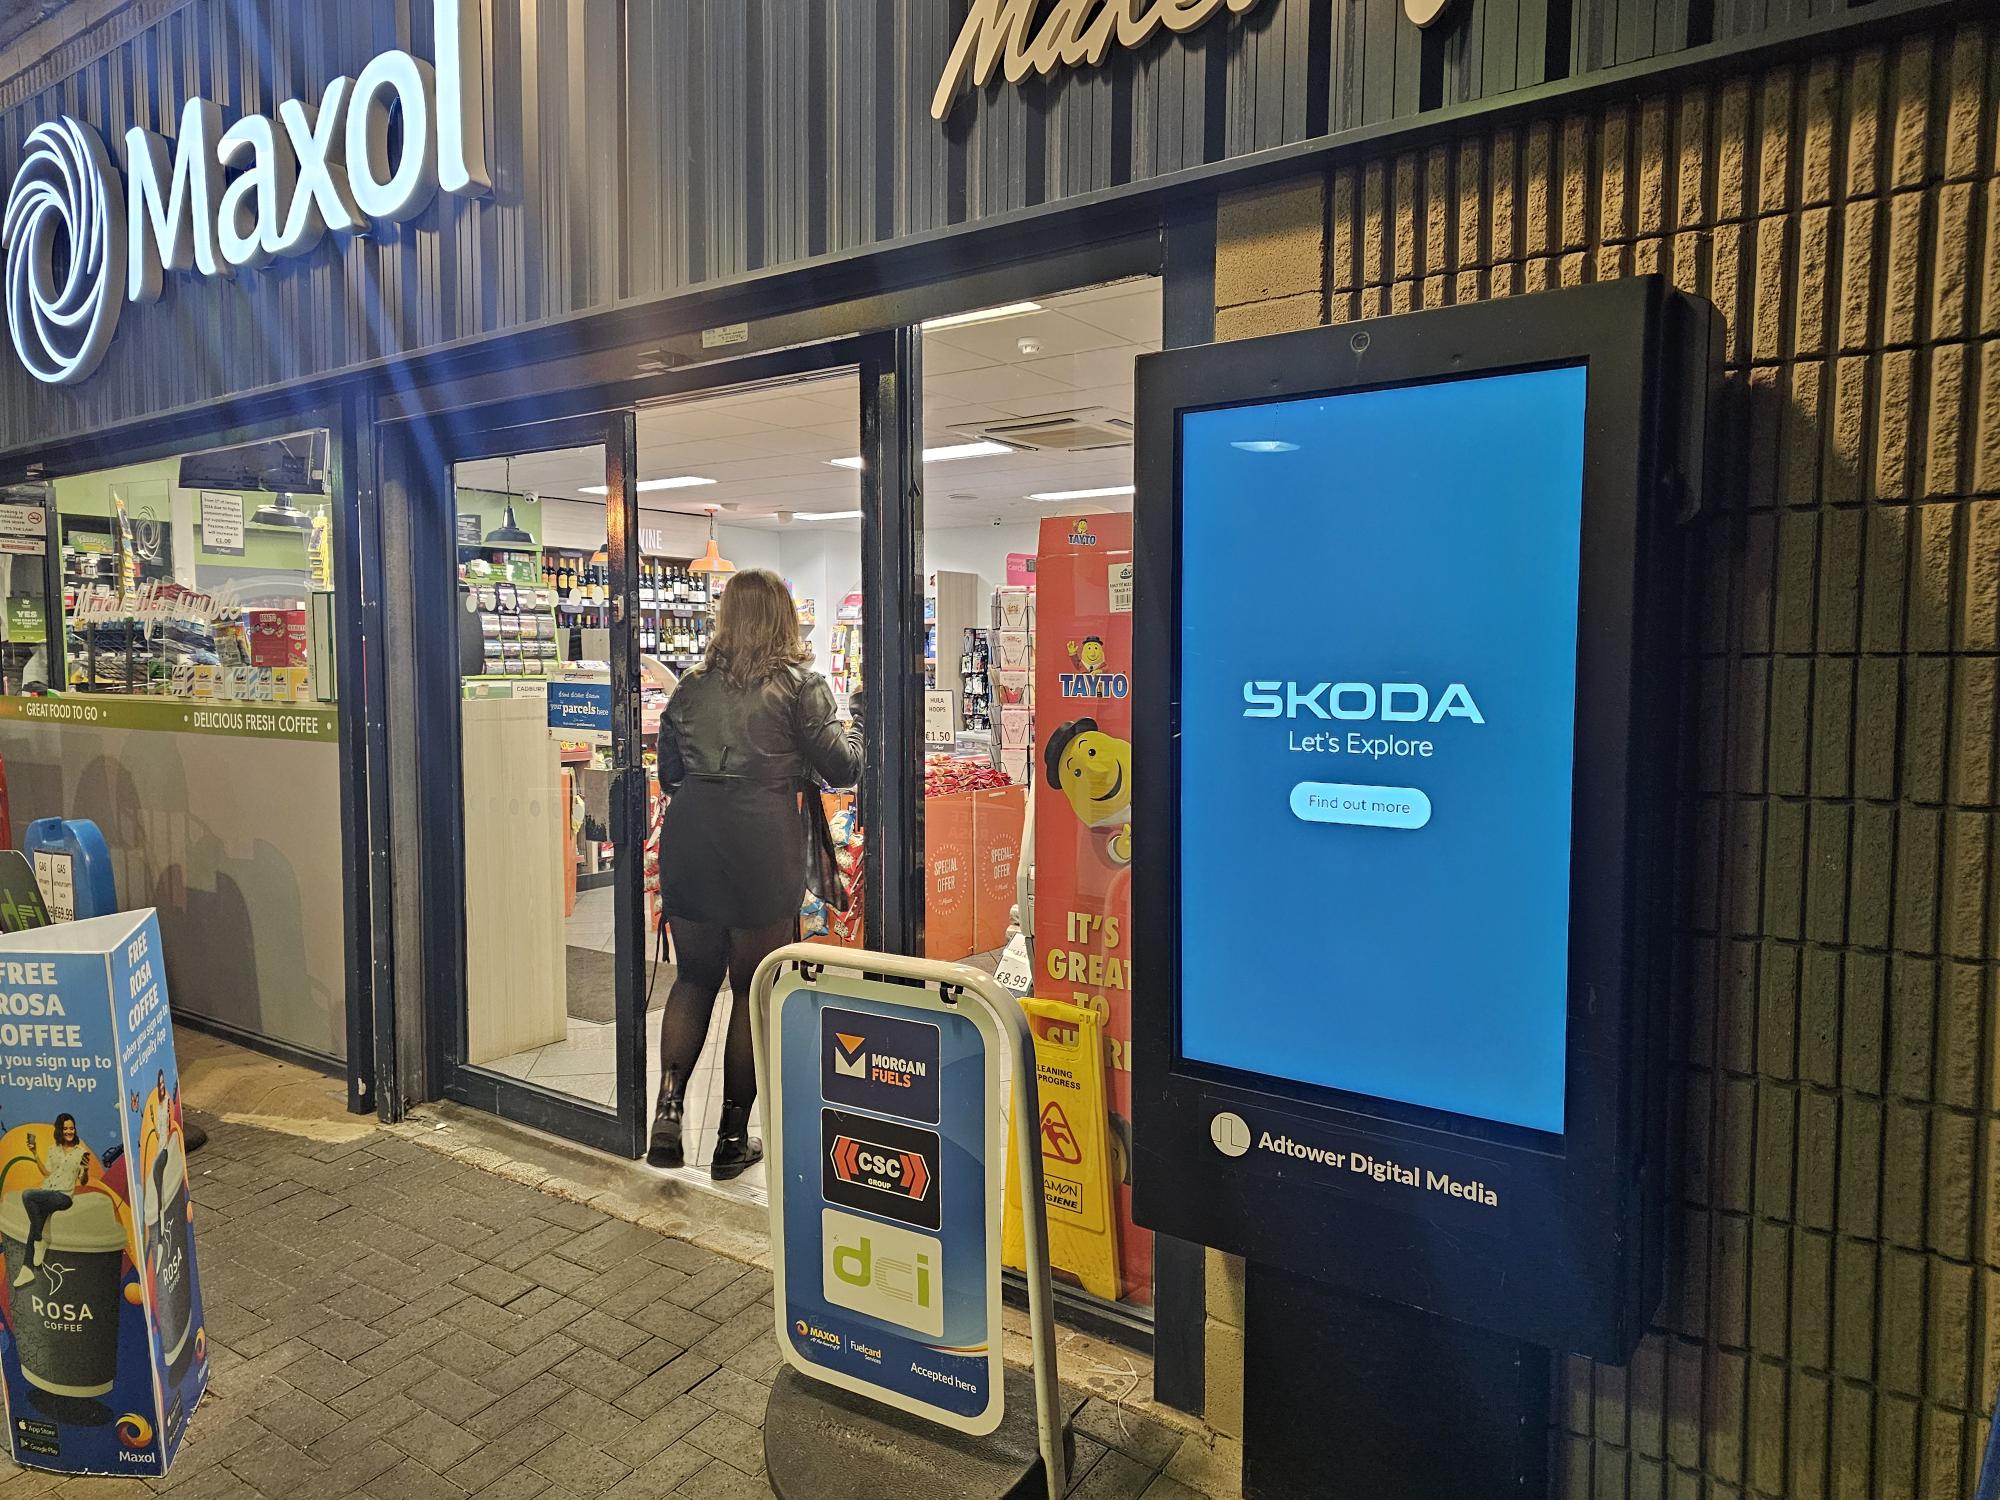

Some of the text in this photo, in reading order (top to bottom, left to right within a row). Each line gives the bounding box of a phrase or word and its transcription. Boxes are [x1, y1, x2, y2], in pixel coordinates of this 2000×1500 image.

[124, 0, 484, 302] Maxol
[1068, 533, 1097, 545] TAYTO
[16, 610, 38, 618] YES
[1059, 672, 1129, 699] TAYTO
[26, 703, 98, 720] GREAT FOOD TO GO
[562, 701, 597, 716] parcels
[193, 712, 319, 734] DELICIOUS FRESH COFFEE
[925, 731, 951, 742] €1.50
[1289, 730, 1434, 761] Let's Explore
[1309, 794, 1411, 814] Find out more
[991, 846, 1013, 863] SPECIAL
[56, 863, 66, 874] GAS
[934, 857, 958, 876] SPECIAL
[993, 863, 1011, 880] OFFER
[937, 876, 956, 893] OFFER
[1067, 911, 1119, 948] IT'S
[127, 931, 148, 968] FREE
[129, 960, 153, 999] ROSA
[996, 971, 1028, 988] €8.99
[0, 993, 66, 1016] ROSA
[128, 983, 160, 1032] COFFEE
[0, 1023, 83, 1047] OFFEE
[5, 1055, 32, 1069] you
[36, 1052, 67, 1071] sign
[71, 1056, 91, 1072] up
[95, 1055, 112, 1069] to
[871, 1053, 926, 1077] MORGAN
[1036, 1063, 1073, 1079] LEANING
[9, 1072, 63, 1092] Loyalty
[66, 1074, 97, 1092] App
[871, 1068, 911, 1088] FUELS
[1037, 1073, 1081, 1090] PROGRESS
[858, 1151, 901, 1178] CSC
[1258, 1131, 1498, 1207] Adtower Digital Media
[867, 1177, 892, 1189] GROUP
[1043, 1179, 1078, 1197] AMON
[1045, 1193, 1078, 1209] GIENE
[162, 1246, 183, 1286] ROSA
[832, 1236, 930, 1309] dci
[31, 1294, 94, 1321] ROSA
[44, 1320, 83, 1332] COFFEE
[809, 1327, 841, 1345] MAXOL
[850, 1340, 881, 1358] Fuelcard
[910, 1362, 977, 1394] Accepted here
[119, 1450, 156, 1463] Maxol
